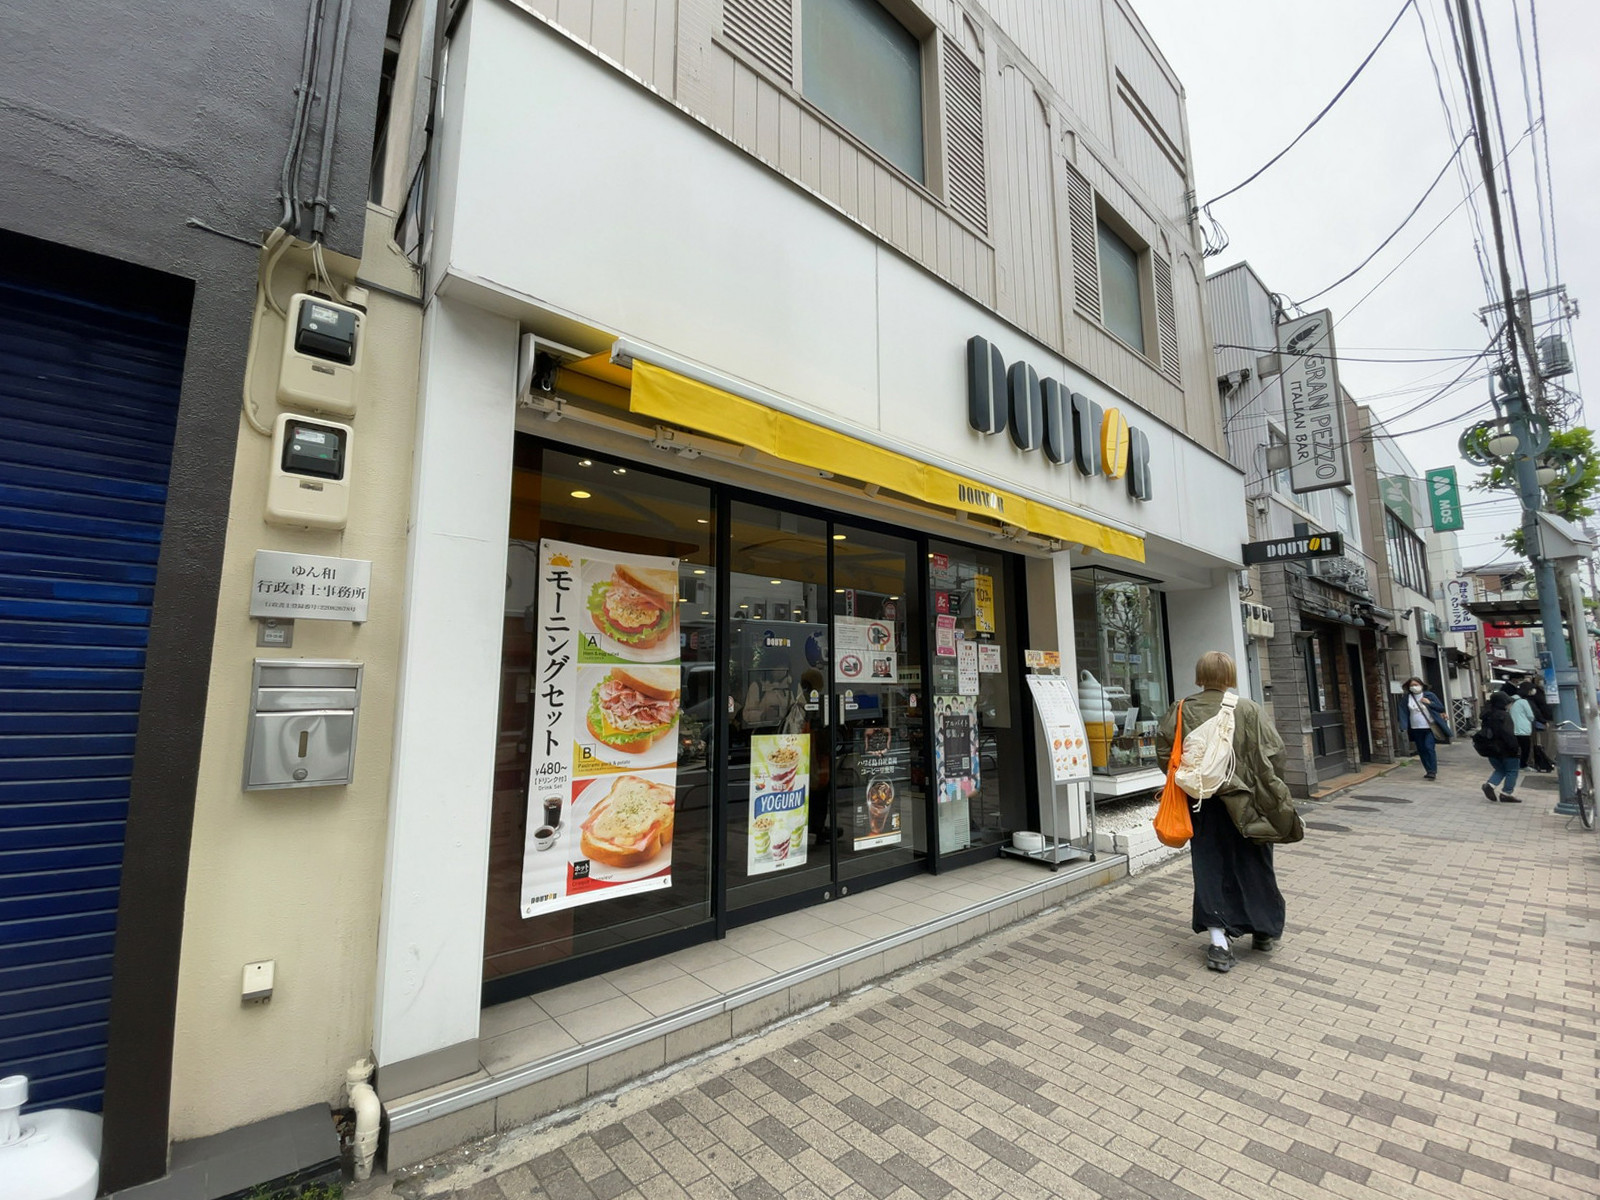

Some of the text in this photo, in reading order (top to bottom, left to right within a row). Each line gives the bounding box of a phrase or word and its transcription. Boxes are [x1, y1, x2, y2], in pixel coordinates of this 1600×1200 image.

[966, 334, 1153, 502] DOUTOR
[1290, 381, 1309, 461] ITALIAN BAR
[1303, 353, 1337, 480] GRAN PEZZO
[958, 483, 1005, 513] DOUTOR
[1439, 499, 1453, 525] MOS
[1266, 536, 1332, 559] DOUTOR
[291, 564, 337, 580] ゆん和
[257, 579, 367, 600] 行政書士事務所
[1450, 597, 1462, 625] クリニック
[587, 635, 597, 647] A
[541, 570, 573, 757] モーニングセット
[582, 747, 592, 760] B
[760, 791, 802, 812] YOGURN
